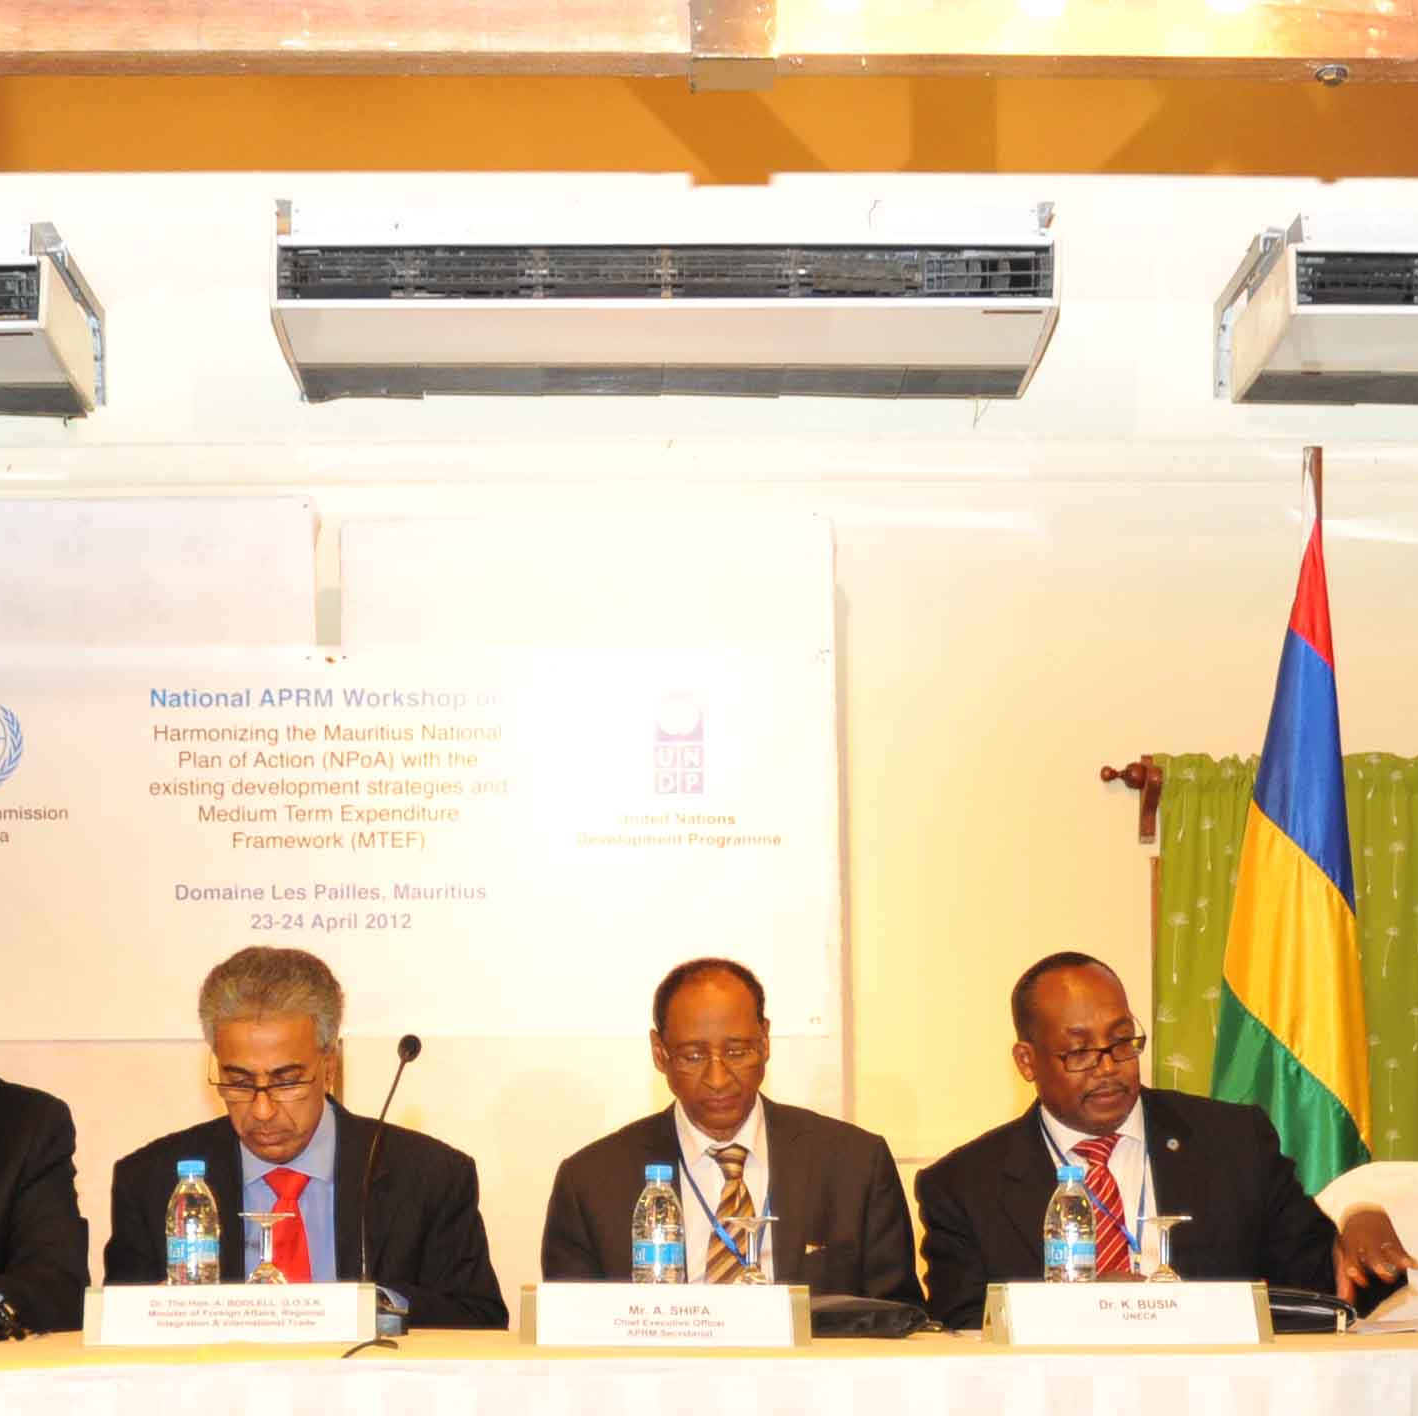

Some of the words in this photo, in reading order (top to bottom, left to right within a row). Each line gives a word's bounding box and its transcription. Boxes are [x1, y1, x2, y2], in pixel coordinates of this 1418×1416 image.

[150, 689, 251, 708] National
[259, 689, 332, 708] APRM
[343, 689, 467, 711] Workshop
[153, 724, 279, 745] Harmonizing
[286, 724, 316, 741] the
[324, 724, 414, 741] Mauritius
[421, 724, 502, 741] National
[178, 751, 221, 769] Plan
[228, 751, 250, 769] of
[254, 751, 314, 769] Action
[322, 751, 394, 772] (NPoA)
[402, 751, 440, 769] with
[449, 751, 478, 769] the
[149, 777, 225, 799] existing
[231, 777, 360, 799] development
[366, 777, 463, 799] strategies
[470, 779, 508, 795] and
[198, 805, 277, 823] Medium
[285, 805, 333, 823] Term
[341, 805, 460, 826] Expenditure
[675, 813, 736, 825] Nations
[232, 832, 342, 850] Framework
[351, 832, 426, 853] (MTEF)
[688, 832, 782, 849] Programme
[174, 883, 264, 901] Domaine
[271, 883, 307, 901] Les
[314, 882, 385, 903] Pailles,
[393, 882, 486, 900] Mauritius
[250, 913, 304, 930] 23-24
[311, 912, 359, 934] April
[365, 912, 412, 930] 2012
[670, 1305, 711, 1316] SHIFA
[1099, 1300, 1118, 1311] Dr.
[1137, 1299, 1179, 1310] BUSIA
[1122, 1312, 1158, 1321] UNECA
